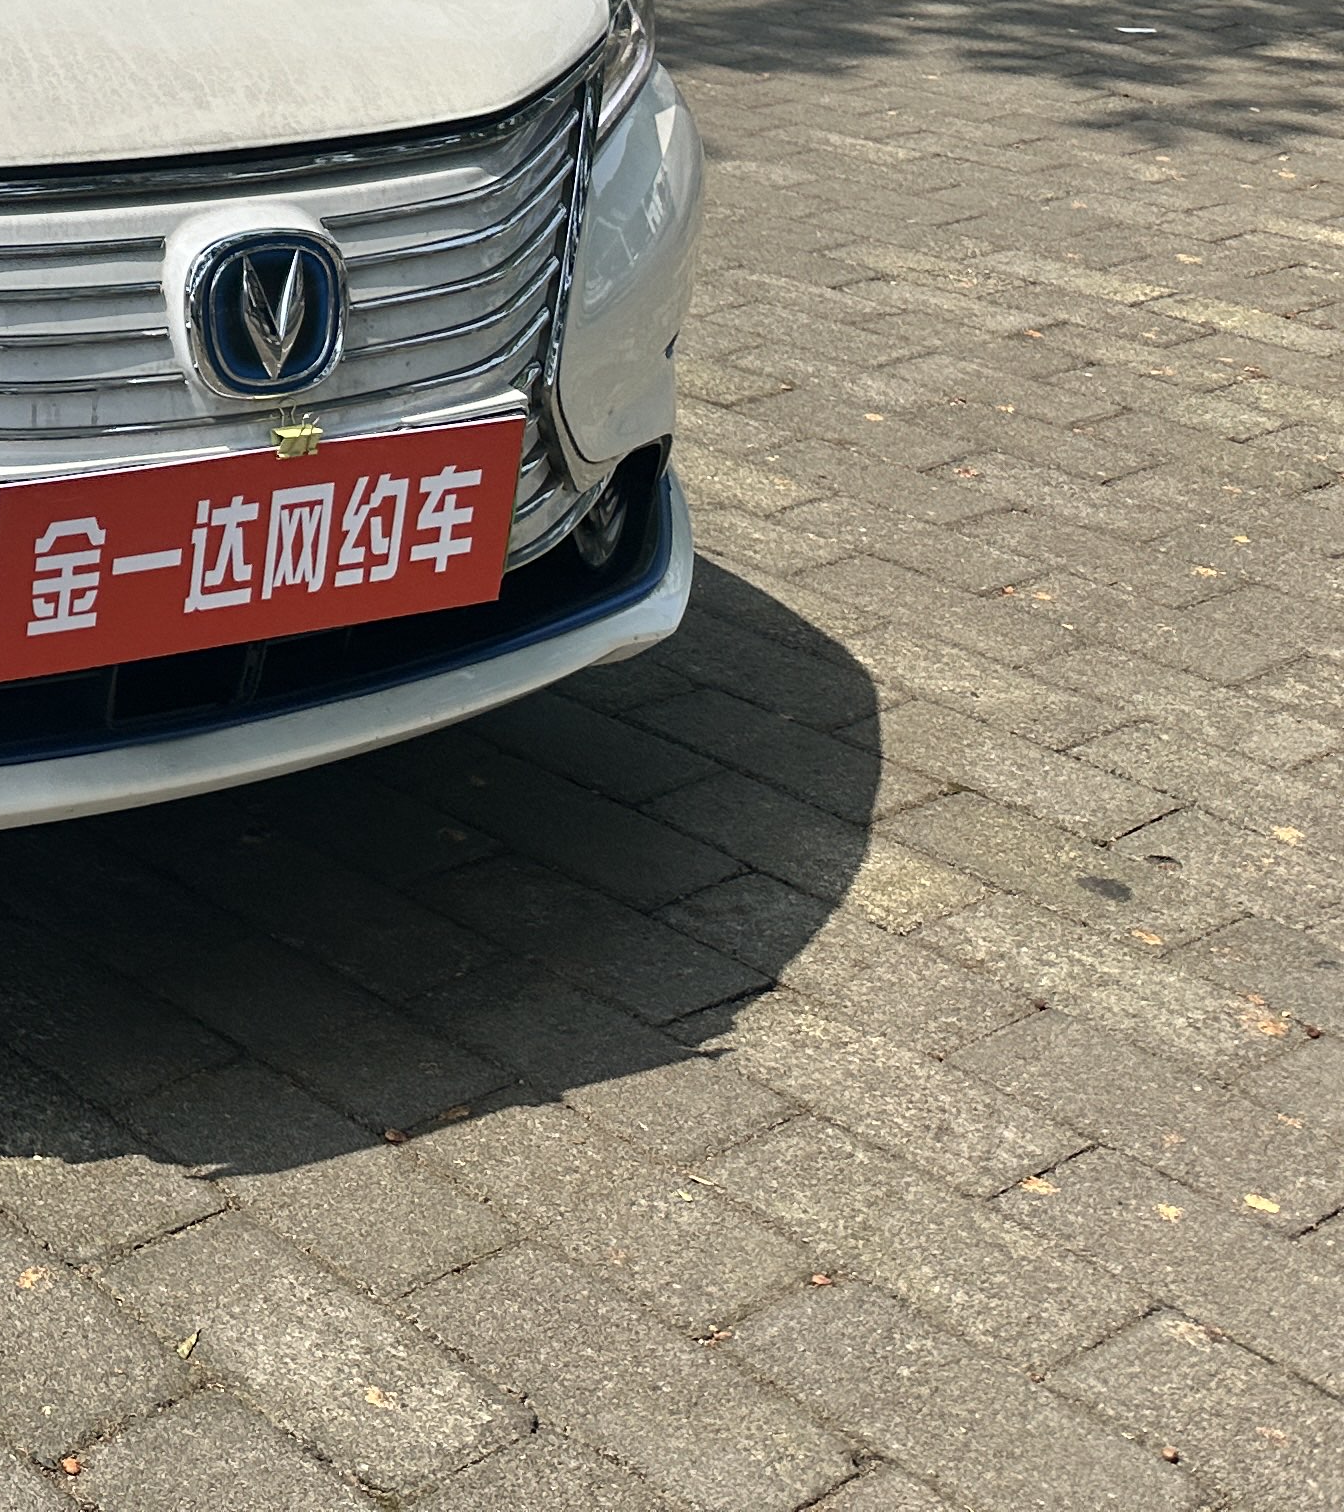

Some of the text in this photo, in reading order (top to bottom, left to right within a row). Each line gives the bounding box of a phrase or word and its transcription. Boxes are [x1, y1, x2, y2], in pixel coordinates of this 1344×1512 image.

[25, 464, 483, 637] 金一达网约车
